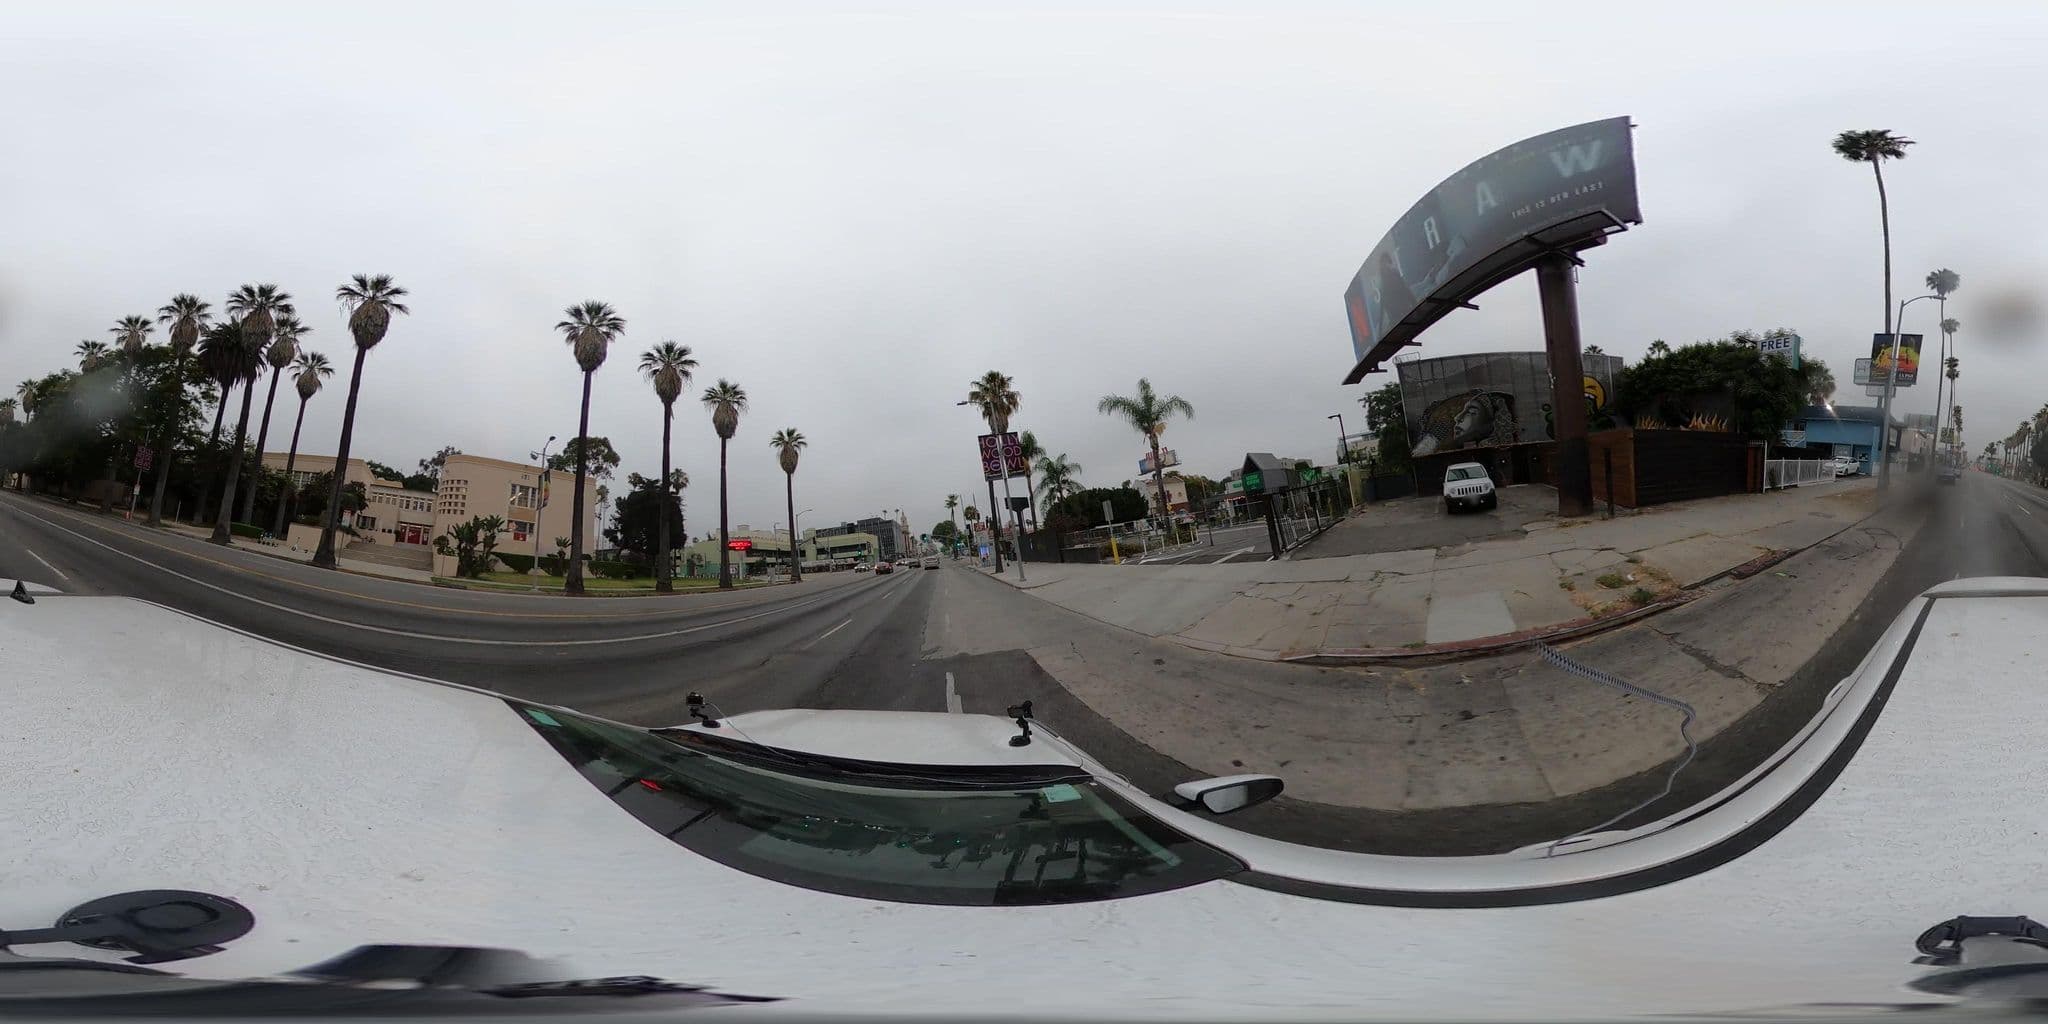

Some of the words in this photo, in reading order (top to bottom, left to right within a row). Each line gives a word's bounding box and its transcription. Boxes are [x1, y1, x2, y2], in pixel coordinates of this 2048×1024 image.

[1760, 337, 1791, 351] FREE
[982, 445, 1022, 459] WOOD
[983, 457, 1025, 472] BOWL
